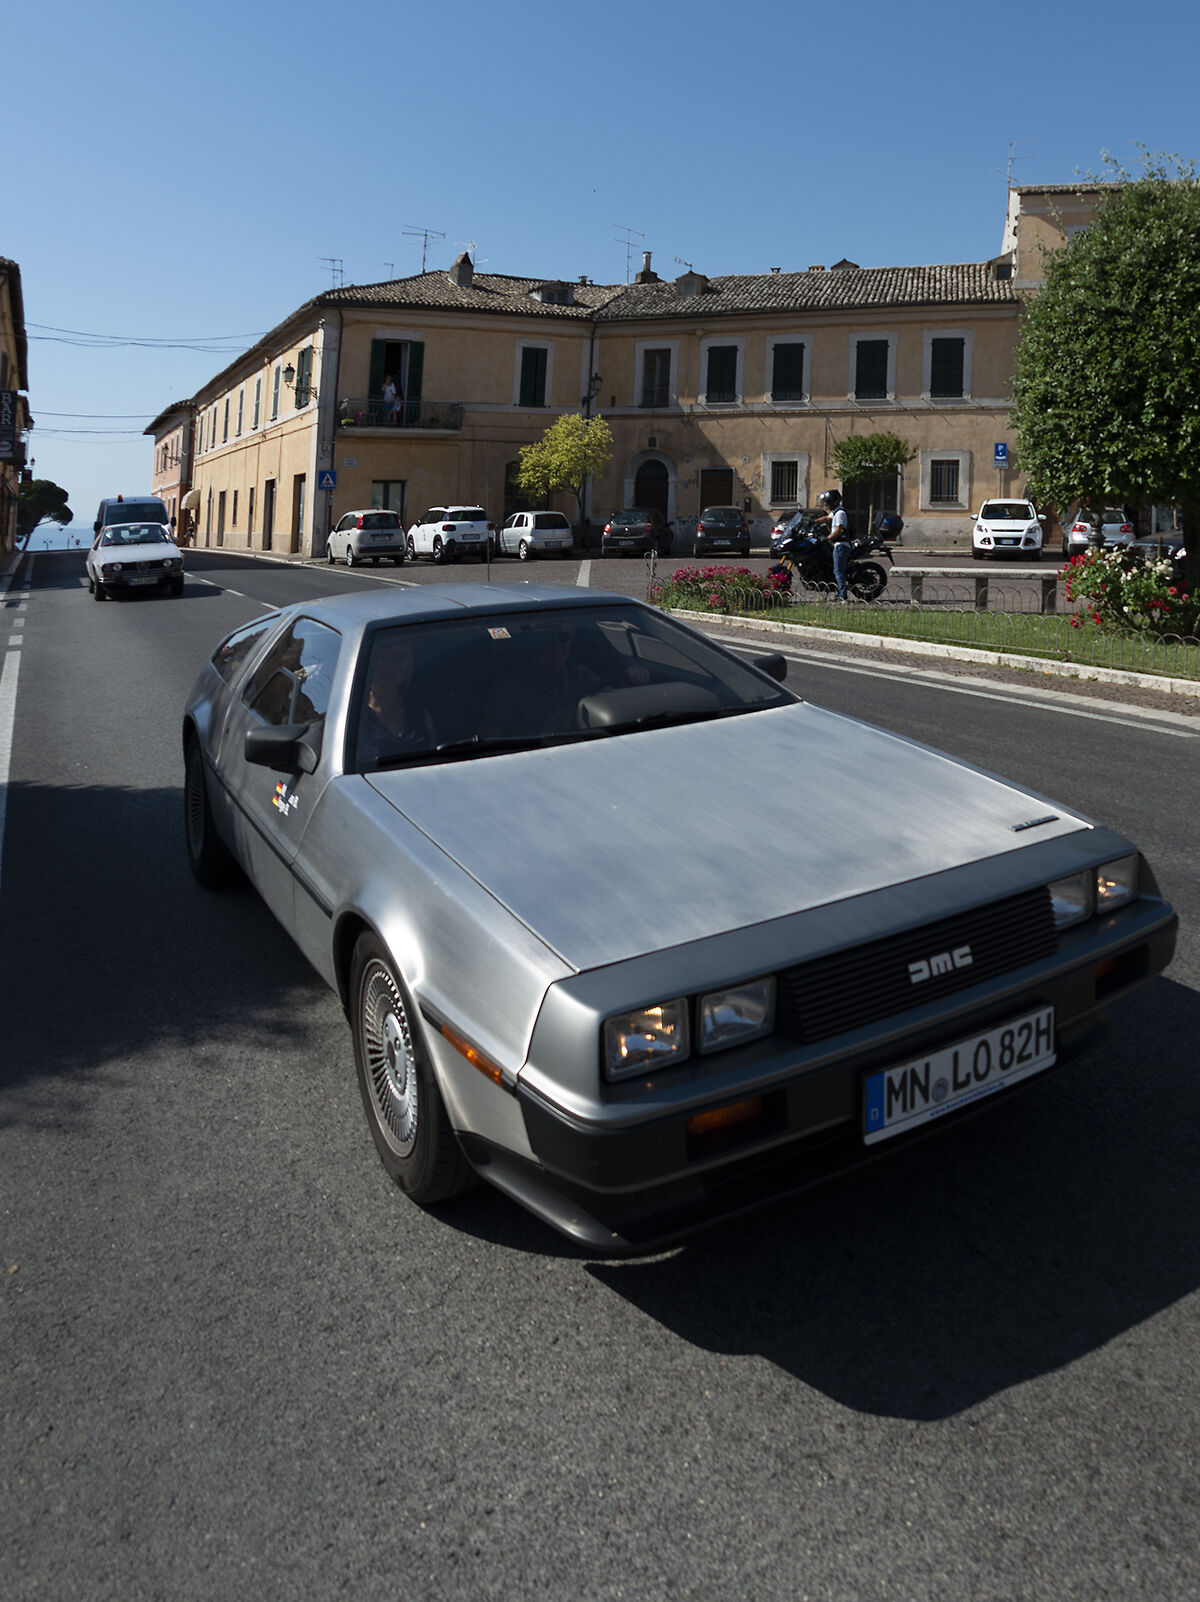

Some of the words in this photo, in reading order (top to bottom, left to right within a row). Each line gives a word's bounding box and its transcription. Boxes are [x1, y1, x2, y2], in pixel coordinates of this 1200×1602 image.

[1, 392, 12, 425] BAR
[886, 1062, 931, 1119] MN
[953, 1038, 992, 1092] LO
[999, 1011, 1052, 1071] 82H
